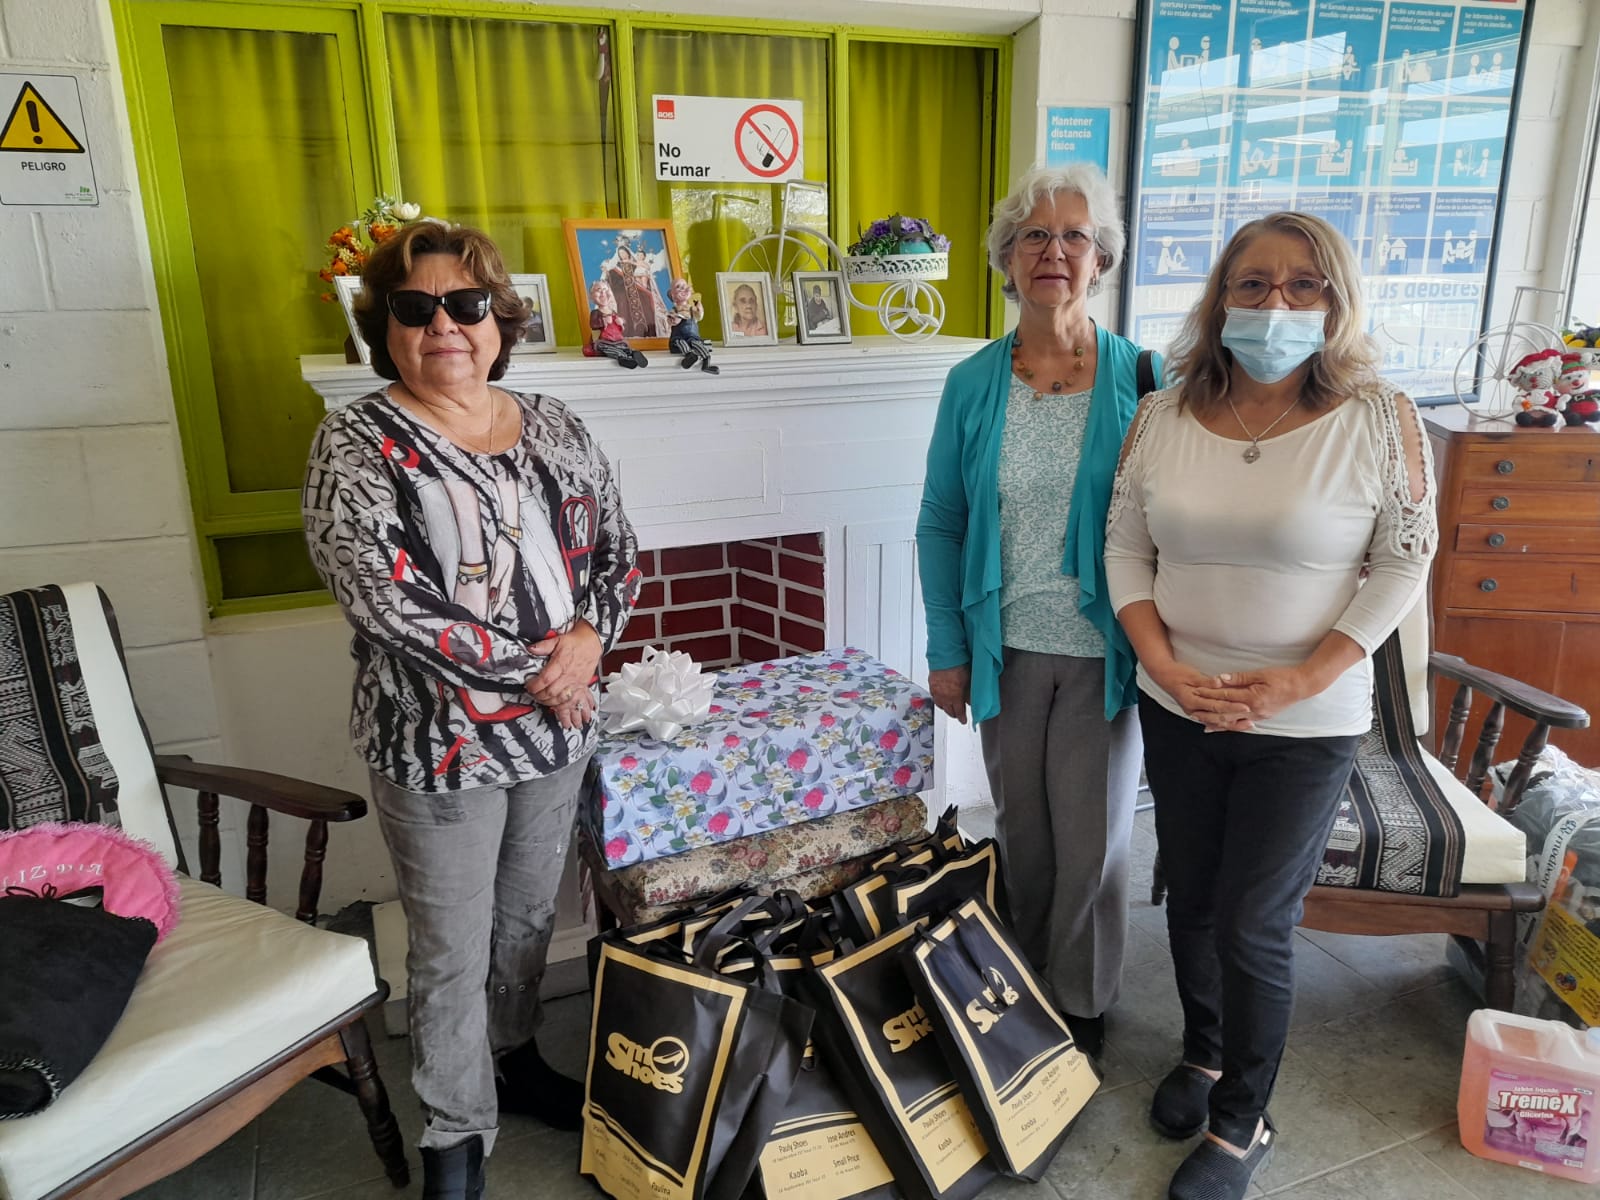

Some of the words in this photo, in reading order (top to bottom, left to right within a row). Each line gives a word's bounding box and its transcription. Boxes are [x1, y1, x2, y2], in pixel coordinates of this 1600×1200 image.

[1052, 116, 1093, 126] Mantener
[1051, 128, 1092, 138] distancia
[659, 143, 681, 158] No
[1051, 140, 1075, 150] física
[21, 161, 66, 171] PELIGRO
[660, 162, 710, 176] Fumar
[1499, 1091, 1578, 1115] TremeX
[932, 1109, 947, 1124] Shoes
[838, 1129, 856, 1140] Andres
[779, 1141, 793, 1153] Pauly
[793, 1139, 809, 1150] Shoes
[938, 1137, 953, 1152] Kaoba
[833, 1156, 847, 1168] Small
[847, 1154, 860, 1164] Price
[789, 1168, 808, 1180] Kaoba
[651, 1181, 671, 1195] Paulina
